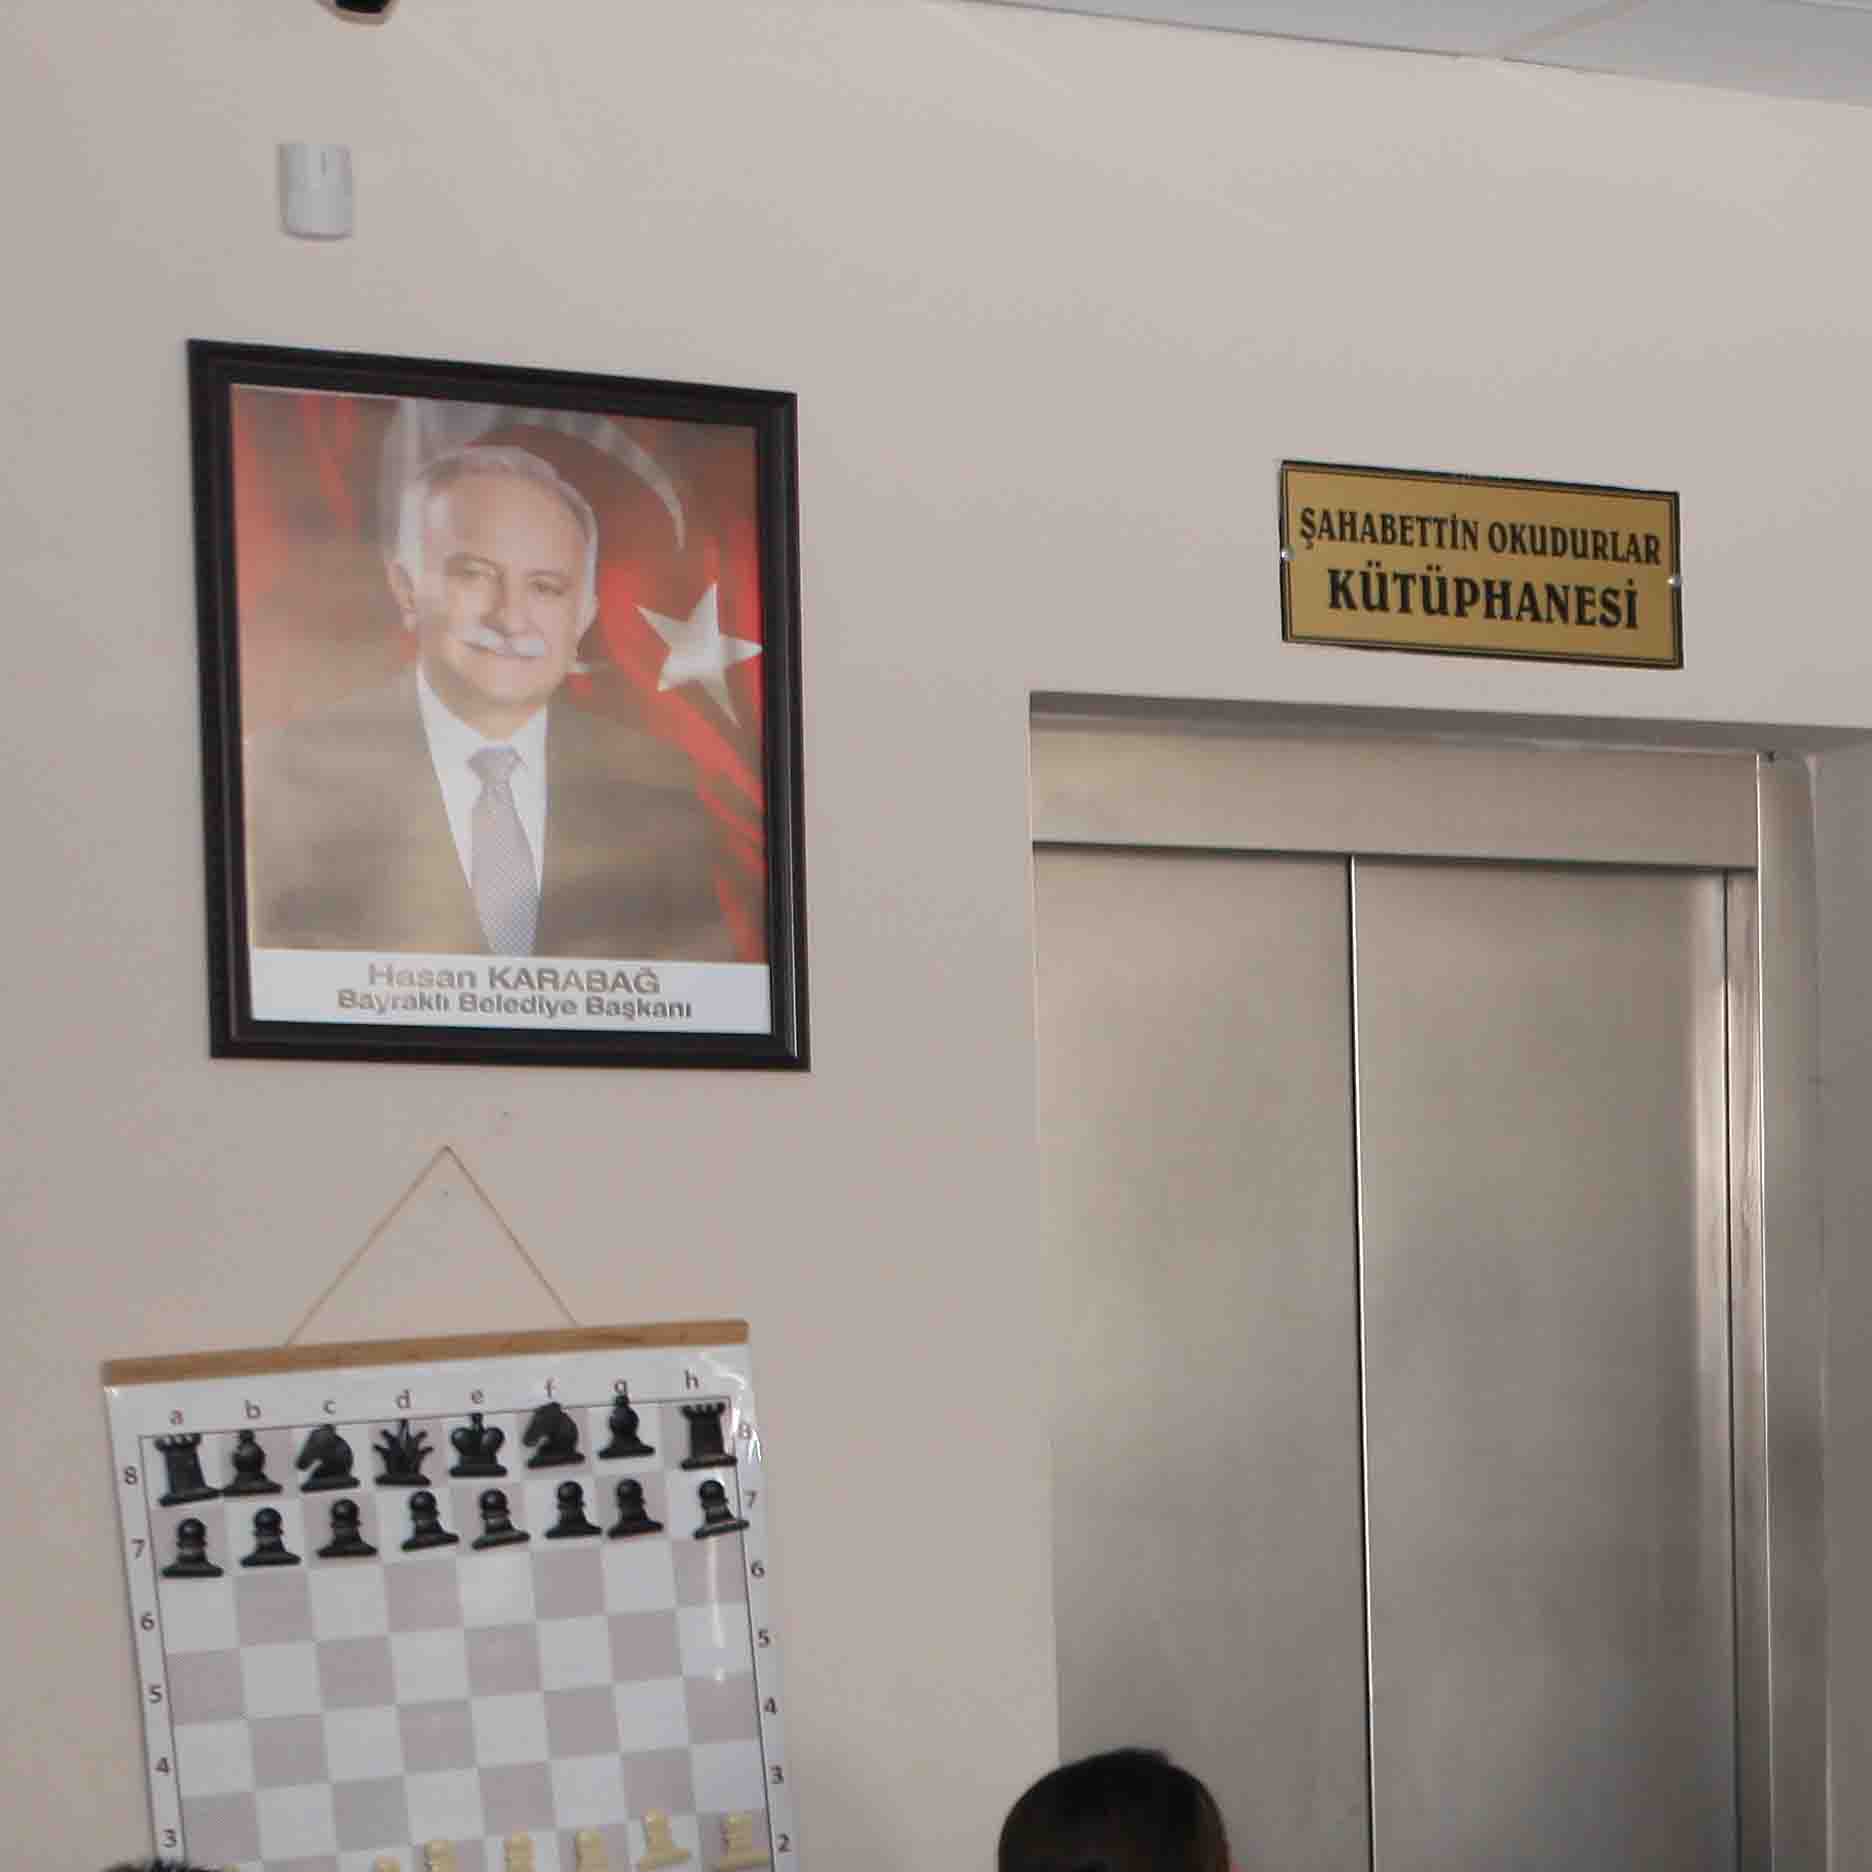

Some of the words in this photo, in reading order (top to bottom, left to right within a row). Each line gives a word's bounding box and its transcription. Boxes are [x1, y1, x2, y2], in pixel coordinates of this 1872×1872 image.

[1300, 506, 1480, 551] ŞAHABETTİN
[1488, 522, 1662, 566] OKUDURLAR
[1327, 560, 1639, 630] KÜTÜPHANESİ
[368, 962, 478, 990] Hasan
[489, 965, 661, 995] KARABAĞ
[336, 988, 450, 1015] Bayraklı
[459, 992, 578, 1019] Belediye
[586, 995, 692, 1022] Başkanı
[170, 1409, 183, 1427] a
[246, 1400, 261, 1420] b
[323, 1400, 337, 1415] c
[395, 1389, 412, 1410] d
[470, 1388, 485, 1406] e
[545, 1379, 557, 1400] f
[684, 1370, 700, 1390] h
[123, 1465, 139, 1486] 8
[745, 1490, 757, 1509] 7
[131, 1540, 147, 1561] 7
[750, 1559, 765, 1578] 6
[140, 1612, 155, 1632] 6
[757, 1628, 771, 1648] 5
[148, 1684, 163, 1705] 5
[763, 1697, 778, 1716] 4
[155, 1755, 171, 1776] 4
[770, 1765, 785, 1786] 3
[163, 1828, 178, 1849] 3
[778, 1833, 793, 1853] 2
